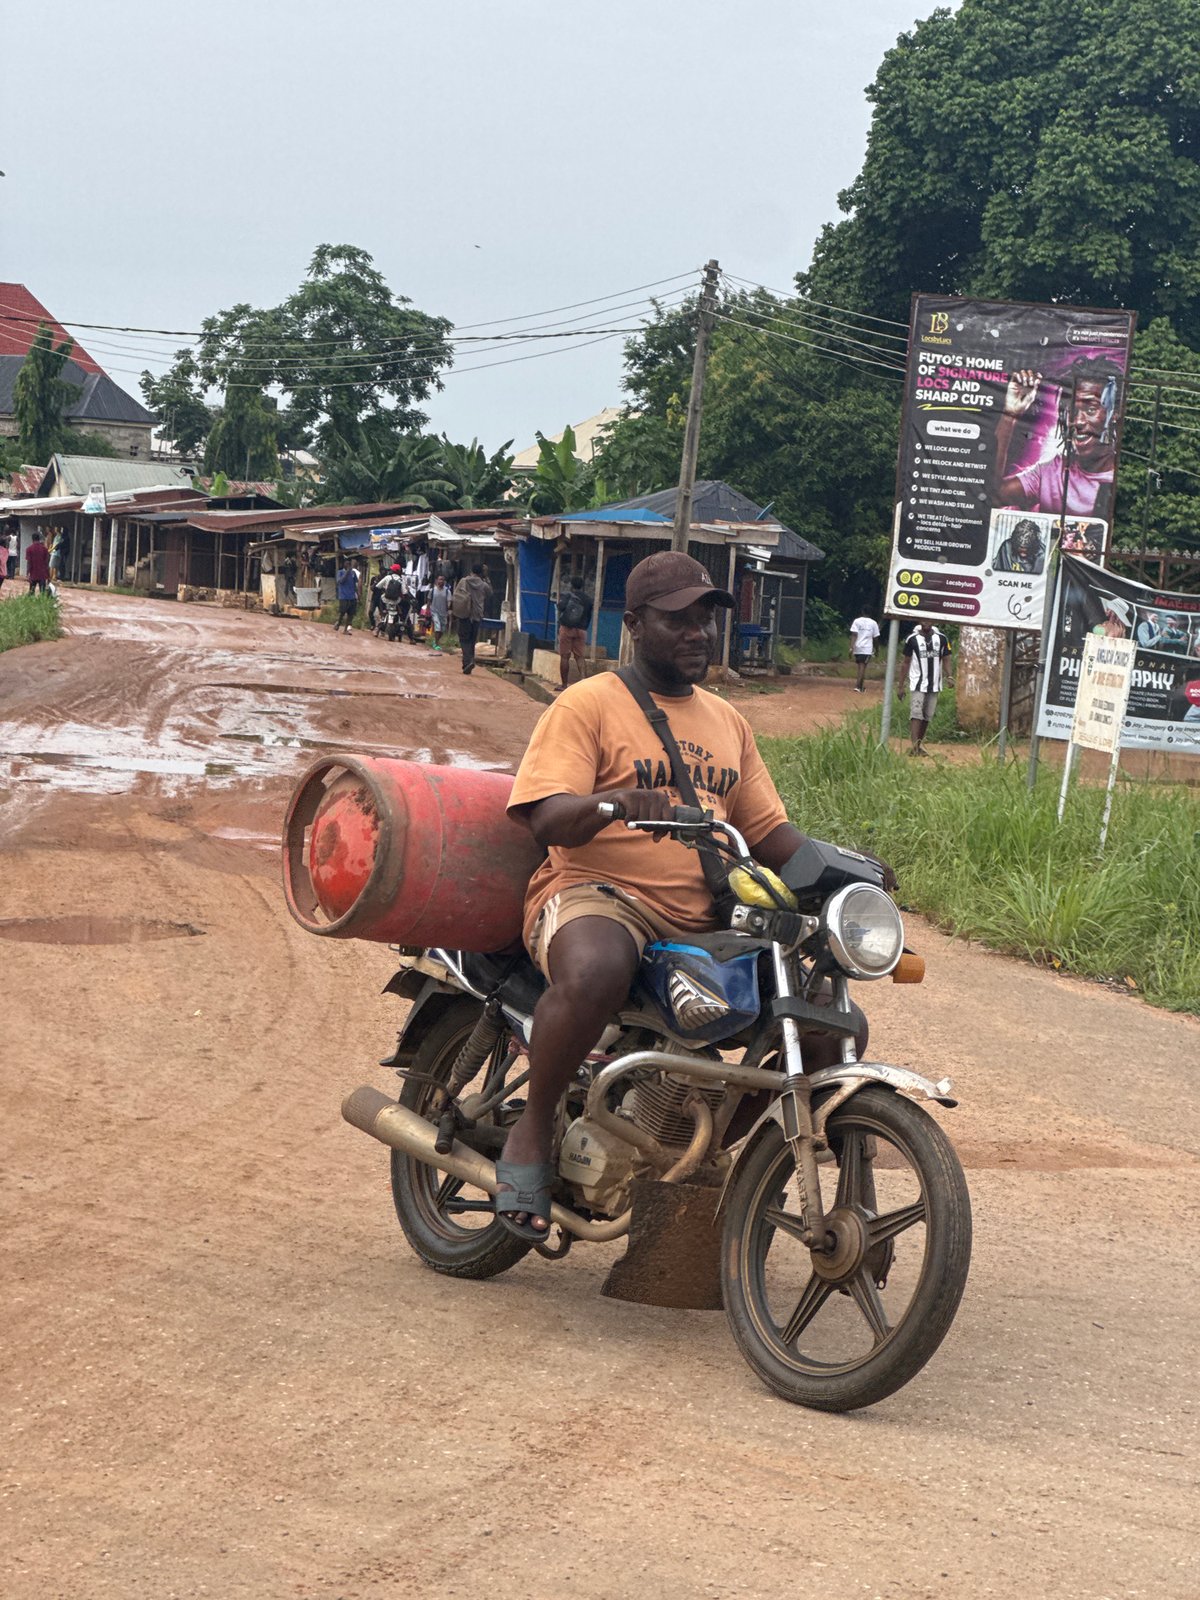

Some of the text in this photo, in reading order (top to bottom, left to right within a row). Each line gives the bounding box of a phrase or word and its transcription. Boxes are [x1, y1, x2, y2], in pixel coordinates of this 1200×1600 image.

[919, 352, 1004, 370] FUTO'S HOME
[918, 364, 1008, 383] OF SIGNATURE
[917, 376, 980, 392] LOCS AND
[915, 389, 994, 406] SHARP CUTS
[998, 580, 1018, 588] SCAN
